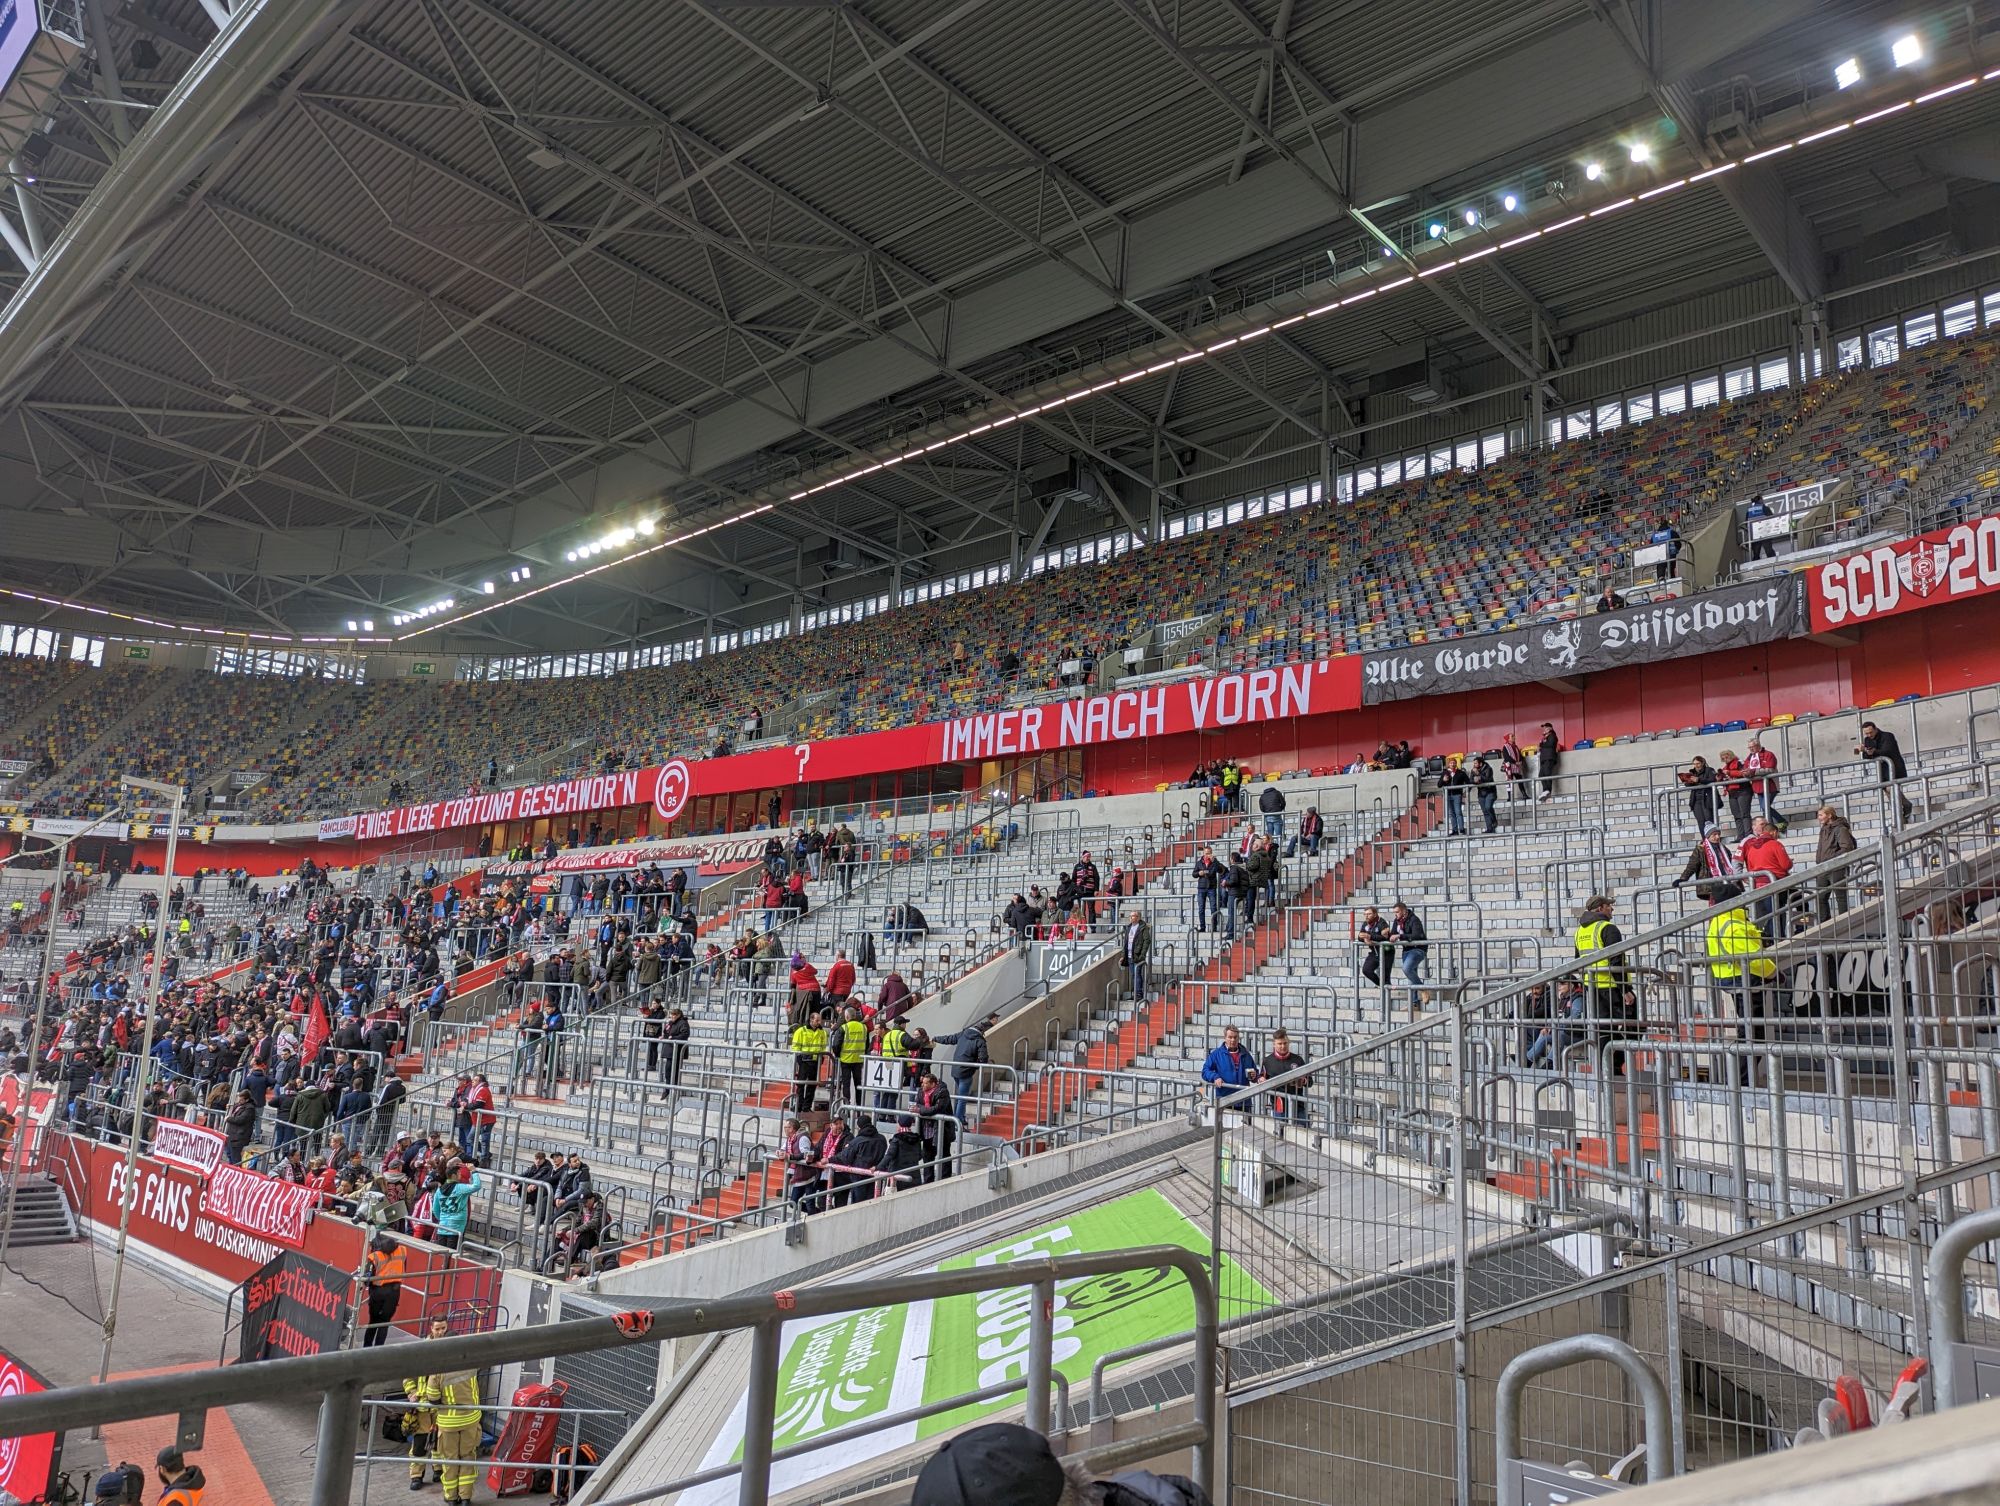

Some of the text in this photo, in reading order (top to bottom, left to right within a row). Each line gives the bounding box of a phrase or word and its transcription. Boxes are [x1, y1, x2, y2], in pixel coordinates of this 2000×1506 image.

[1789, 491, 1819, 511] 158
[1821, 547, 1900, 624] SCD
[1166, 625, 1182, 640] 155
[1365, 651, 1424, 687] Alte
[1435, 640, 1529, 677] Garde
[943, 707, 1042, 762] IMMER
[1060, 687, 1166, 746] NACH
[794, 743, 811, 782] ?
[320, 818, 349, 834] FANCLUB
[357, 771, 638, 840] EWIGE LIEBE FORTUNA GESCHWOR'N
[1049, 954, 1069, 976] 40
[874, 1062, 893, 1086] 41
[156, 1125, 221, 1171] DANGERMOUTH
[107, 1161, 193, 1232] F95 FANS
[194, 1217, 215, 1243] UND
[787, 1321, 849, 1396] Düsseldorf
[837, 1306, 893, 1382] Stadtwerke
